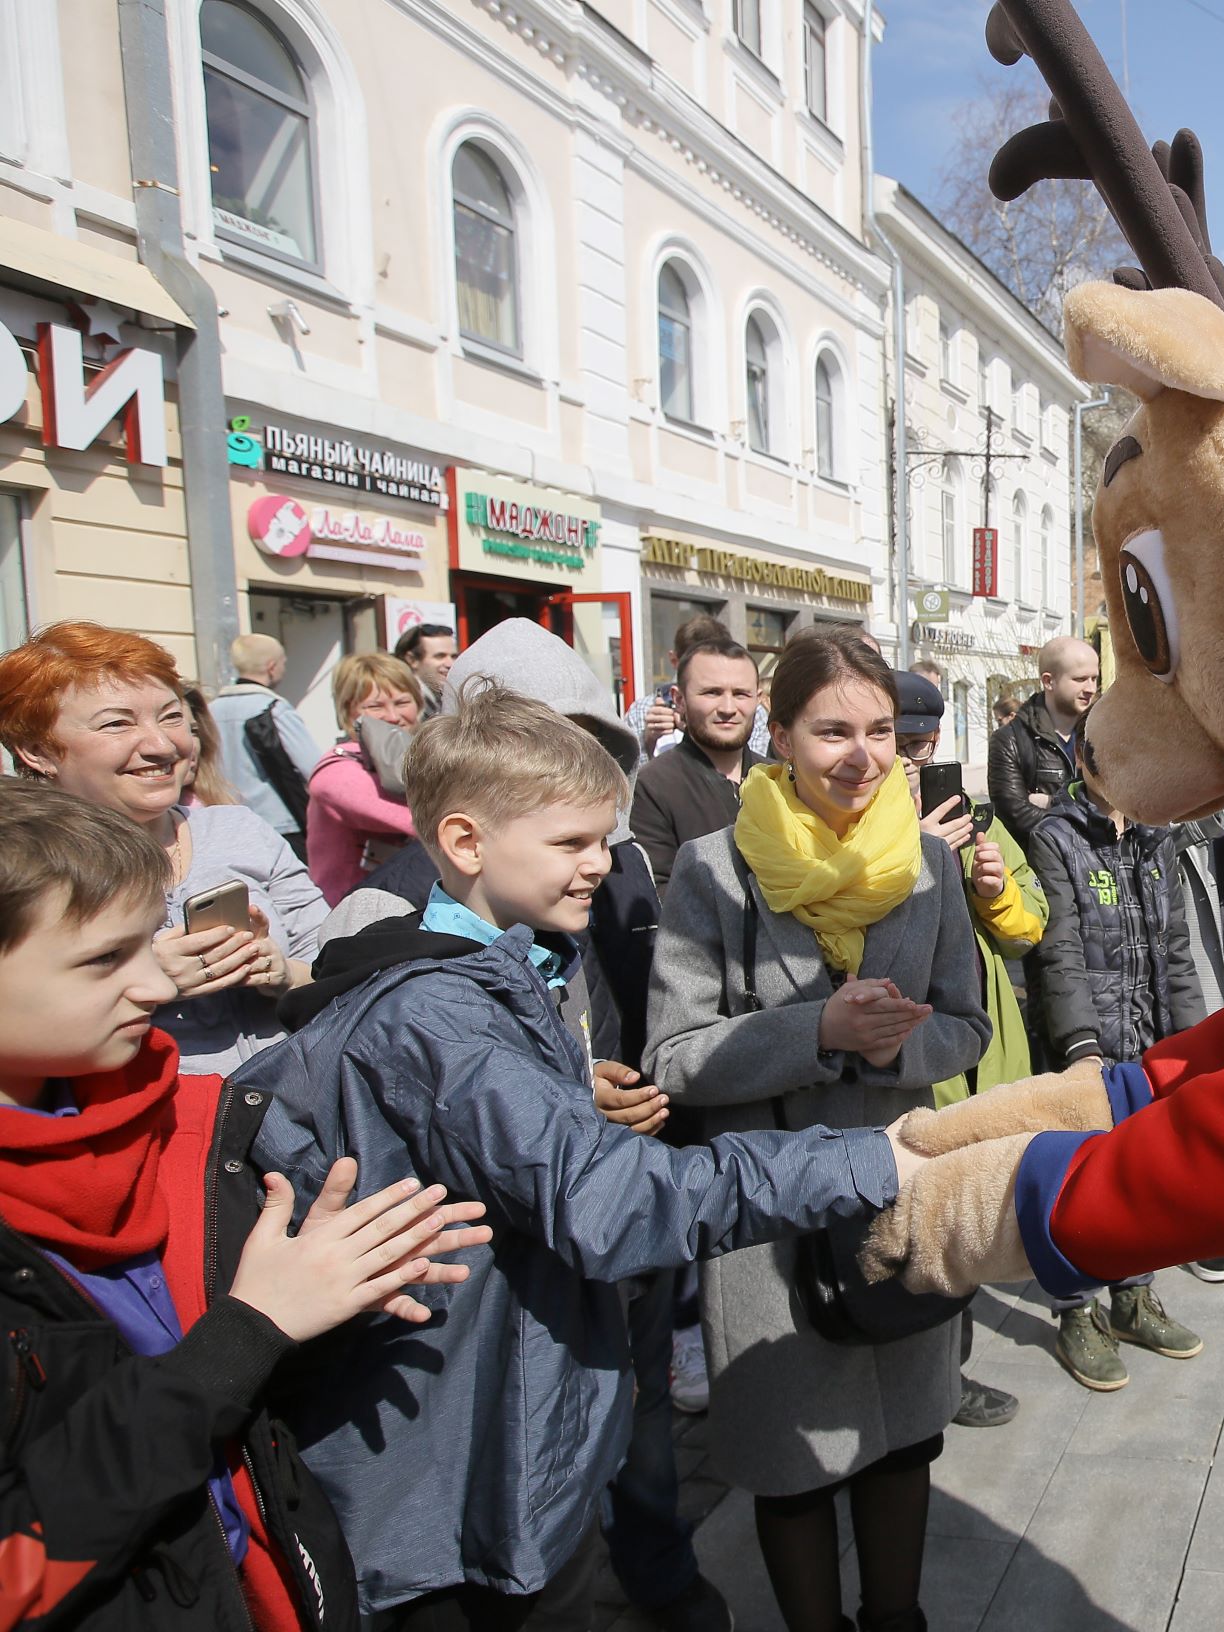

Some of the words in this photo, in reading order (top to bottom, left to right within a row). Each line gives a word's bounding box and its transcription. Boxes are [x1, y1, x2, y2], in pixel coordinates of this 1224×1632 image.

[265, 426, 353, 467] ПЬЯНЫЙ
[357, 449, 443, 488] ЧАЙНИЦА
[271, 456, 358, 487] магазин
[487, 496, 588, 547] МАДЖОНГ
[649, 538, 697, 568] МИР
